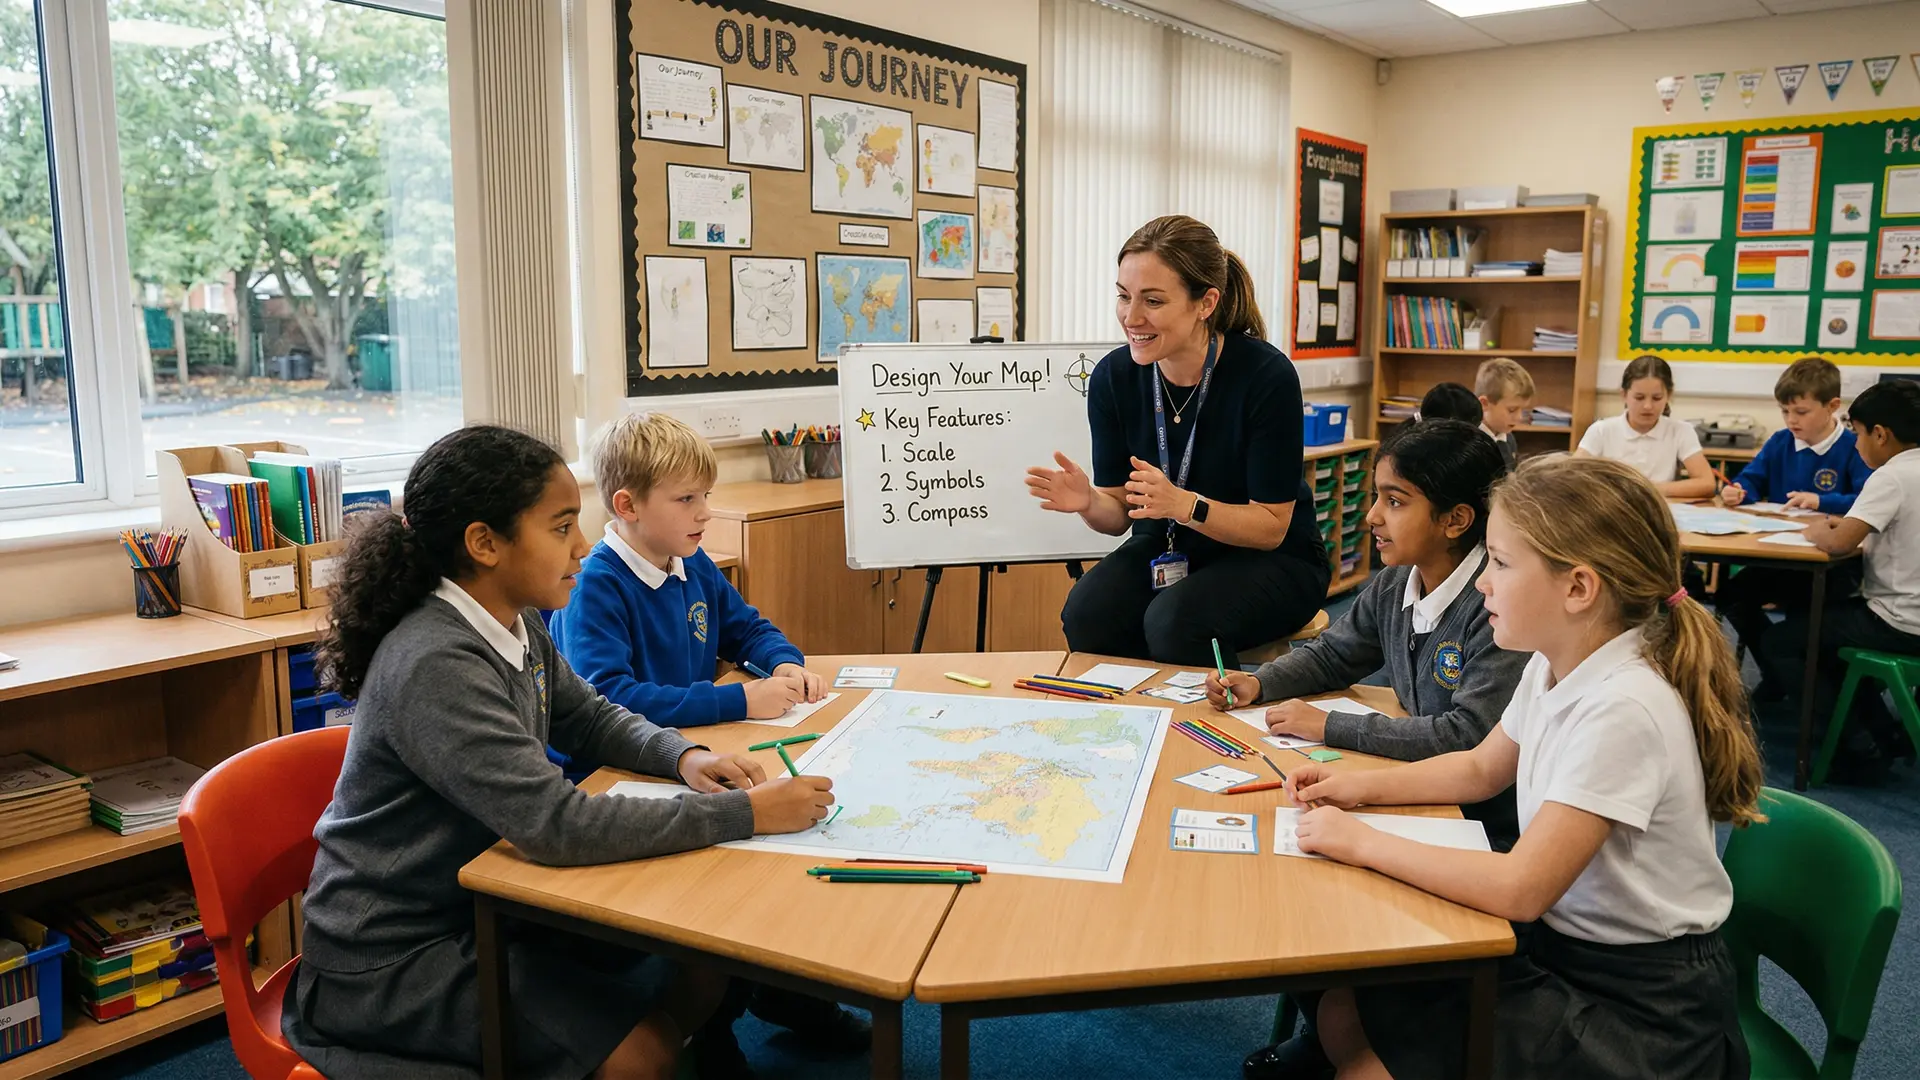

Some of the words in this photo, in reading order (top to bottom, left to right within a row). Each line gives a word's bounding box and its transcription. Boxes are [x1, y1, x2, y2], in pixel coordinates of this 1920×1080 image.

[714, 18, 799, 77] OUR
[819, 41, 969, 109] JOURNEY
[872, 363, 941, 397] Design
[949, 362, 993, 386] Your
[1001, 358, 1051, 393] Map!
[884, 407, 920, 438] Key
[927, 406, 1012, 428] Features:
[881, 443, 892, 463] 1.
[903, 441, 956, 463] Scale
[880, 473, 898, 492] 2.
[905, 470, 985, 499] Symbols
[882, 504, 899, 524] 3.
[907, 501, 989, 527] Compass
